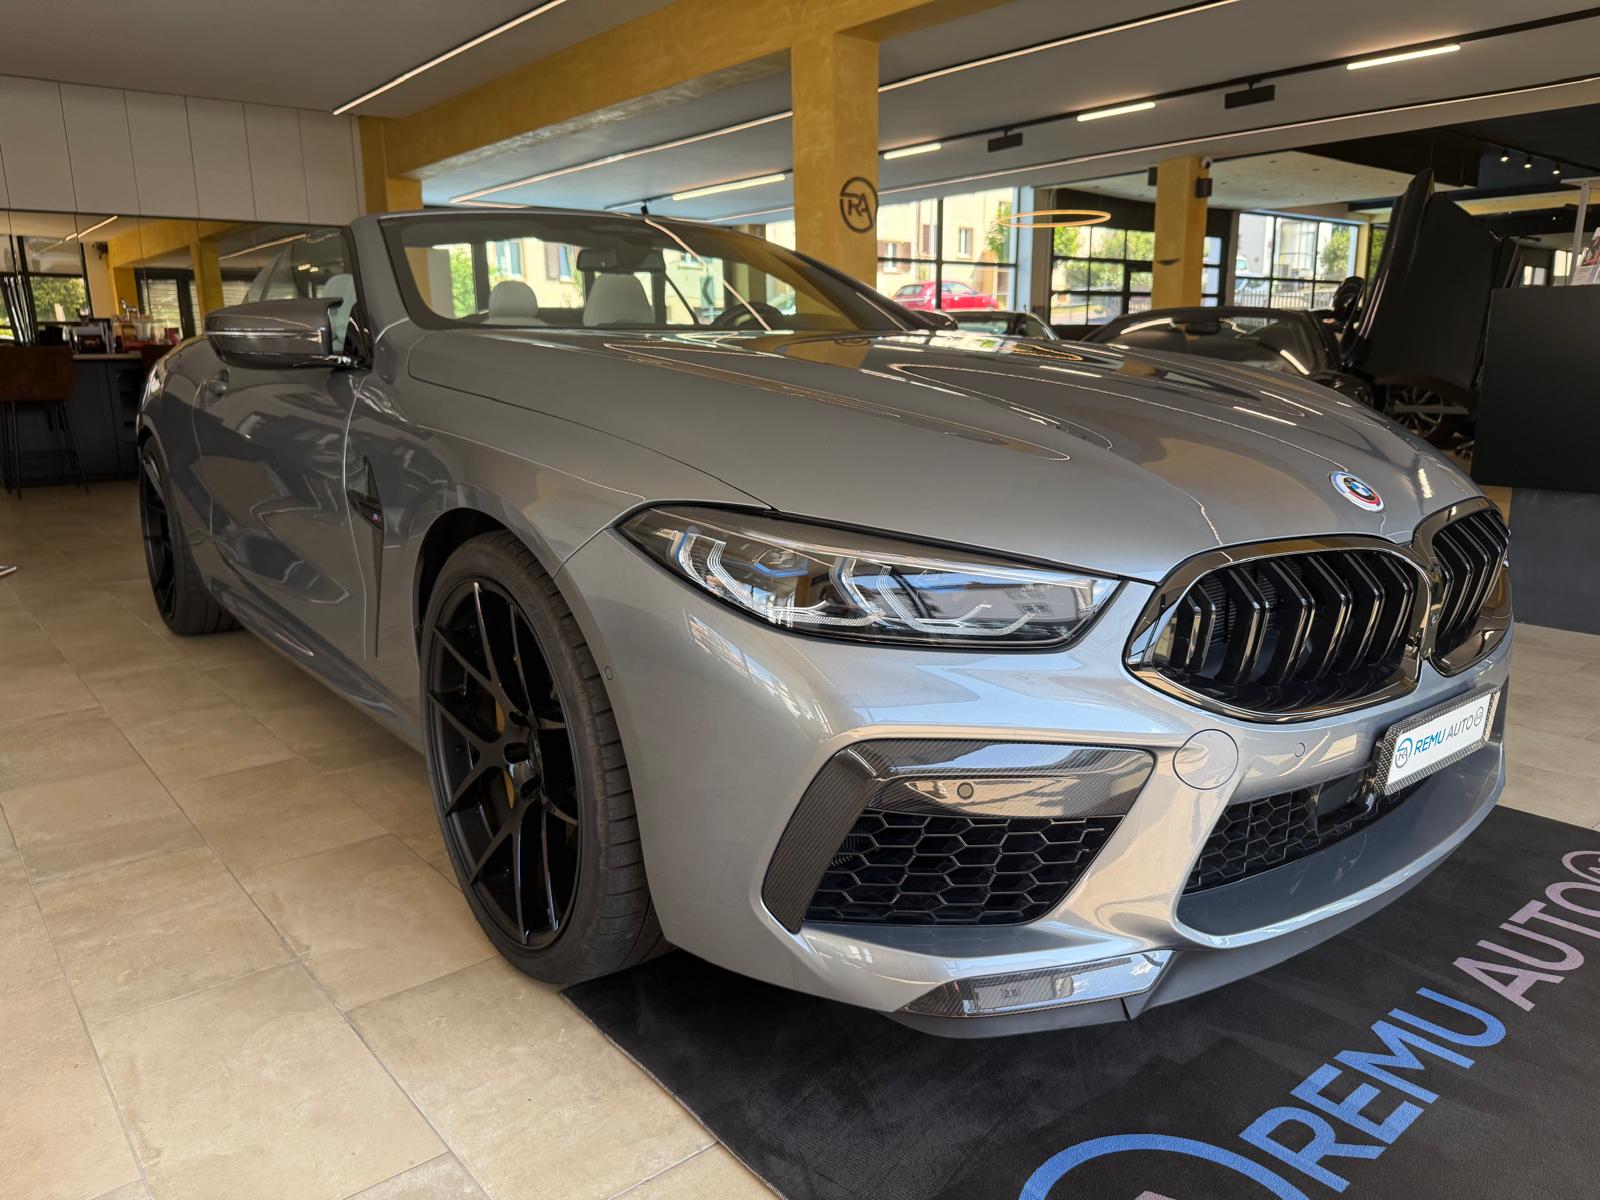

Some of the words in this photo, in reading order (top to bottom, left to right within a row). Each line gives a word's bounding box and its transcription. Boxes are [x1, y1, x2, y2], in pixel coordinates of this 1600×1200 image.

[1414, 729, 1446, 756] REMU
[1447, 714, 1473, 739] AUTO
[1239, 987, 1507, 1193] REMU
